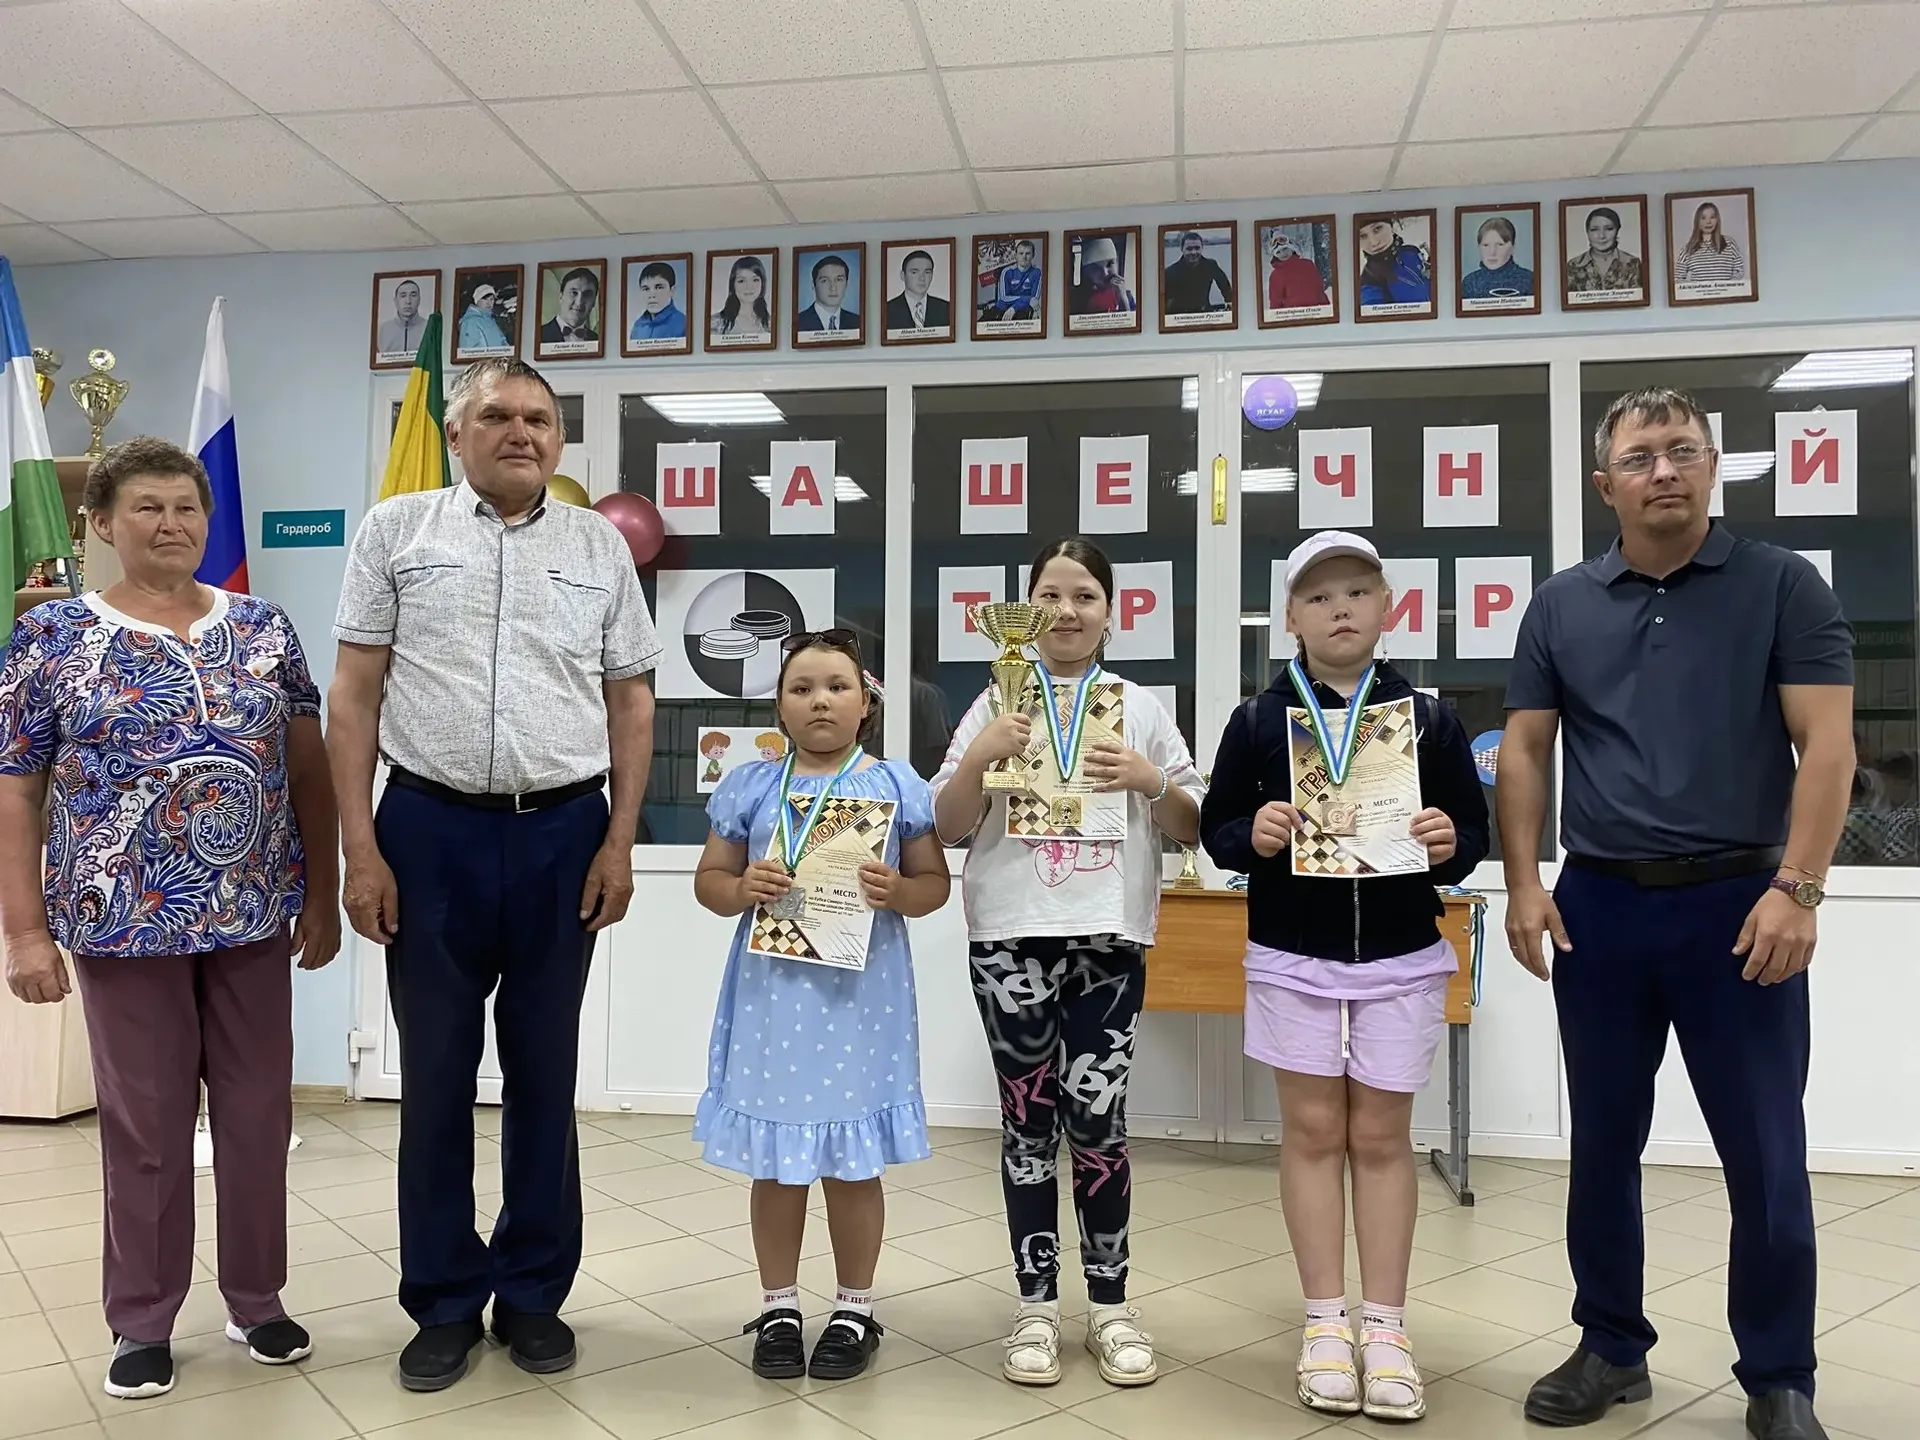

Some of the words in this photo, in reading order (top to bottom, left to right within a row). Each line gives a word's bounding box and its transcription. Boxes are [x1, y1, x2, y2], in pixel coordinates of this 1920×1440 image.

[1256, 408, 1285, 416] ЯГУАР
[276, 522, 331, 536] Гардероб
[1373, 797, 1399, 807] МЕСТО
[833, 889, 857, 898] МЕСТО
